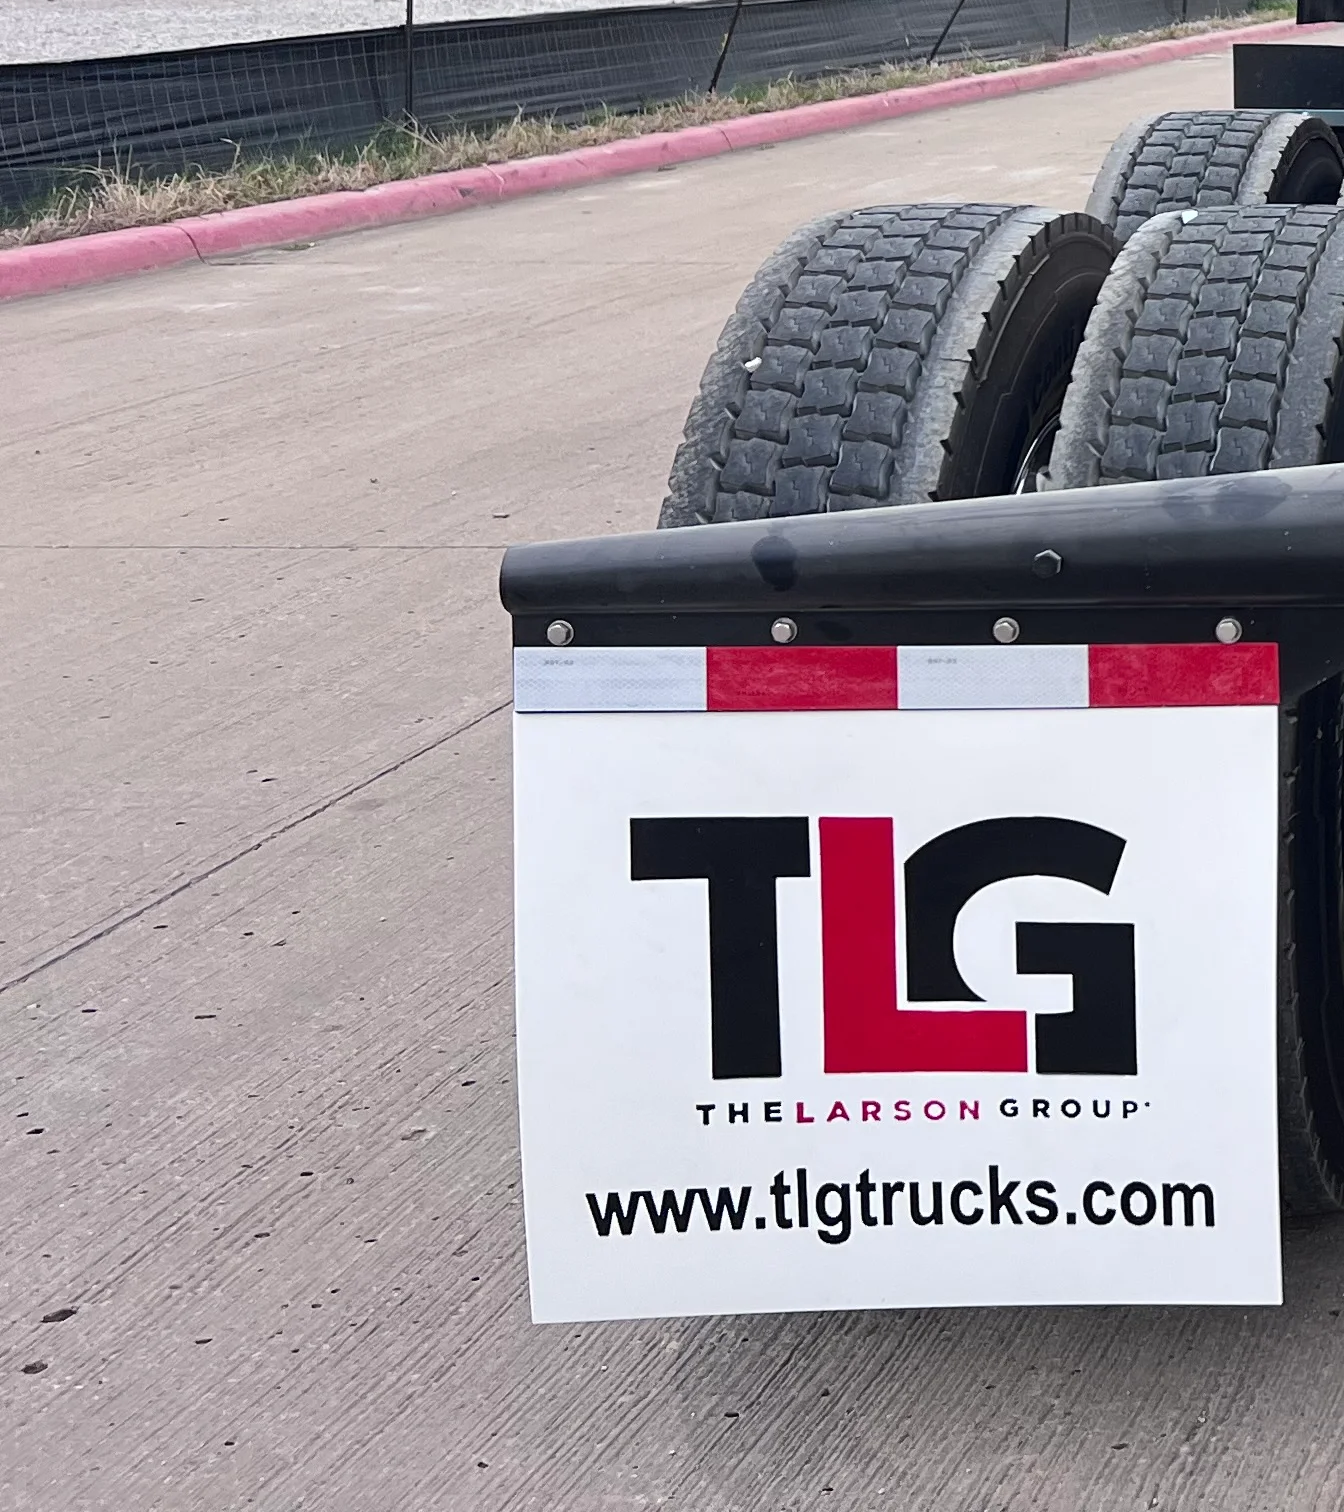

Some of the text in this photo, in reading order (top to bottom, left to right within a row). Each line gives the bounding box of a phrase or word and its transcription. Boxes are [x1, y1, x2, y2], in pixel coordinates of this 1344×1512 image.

[630, 816, 1138, 1079] TLG
[1000, 1098, 1139, 1120] GROUP
[586, 1165, 1216, 1245] www.tlgtrucks.com
